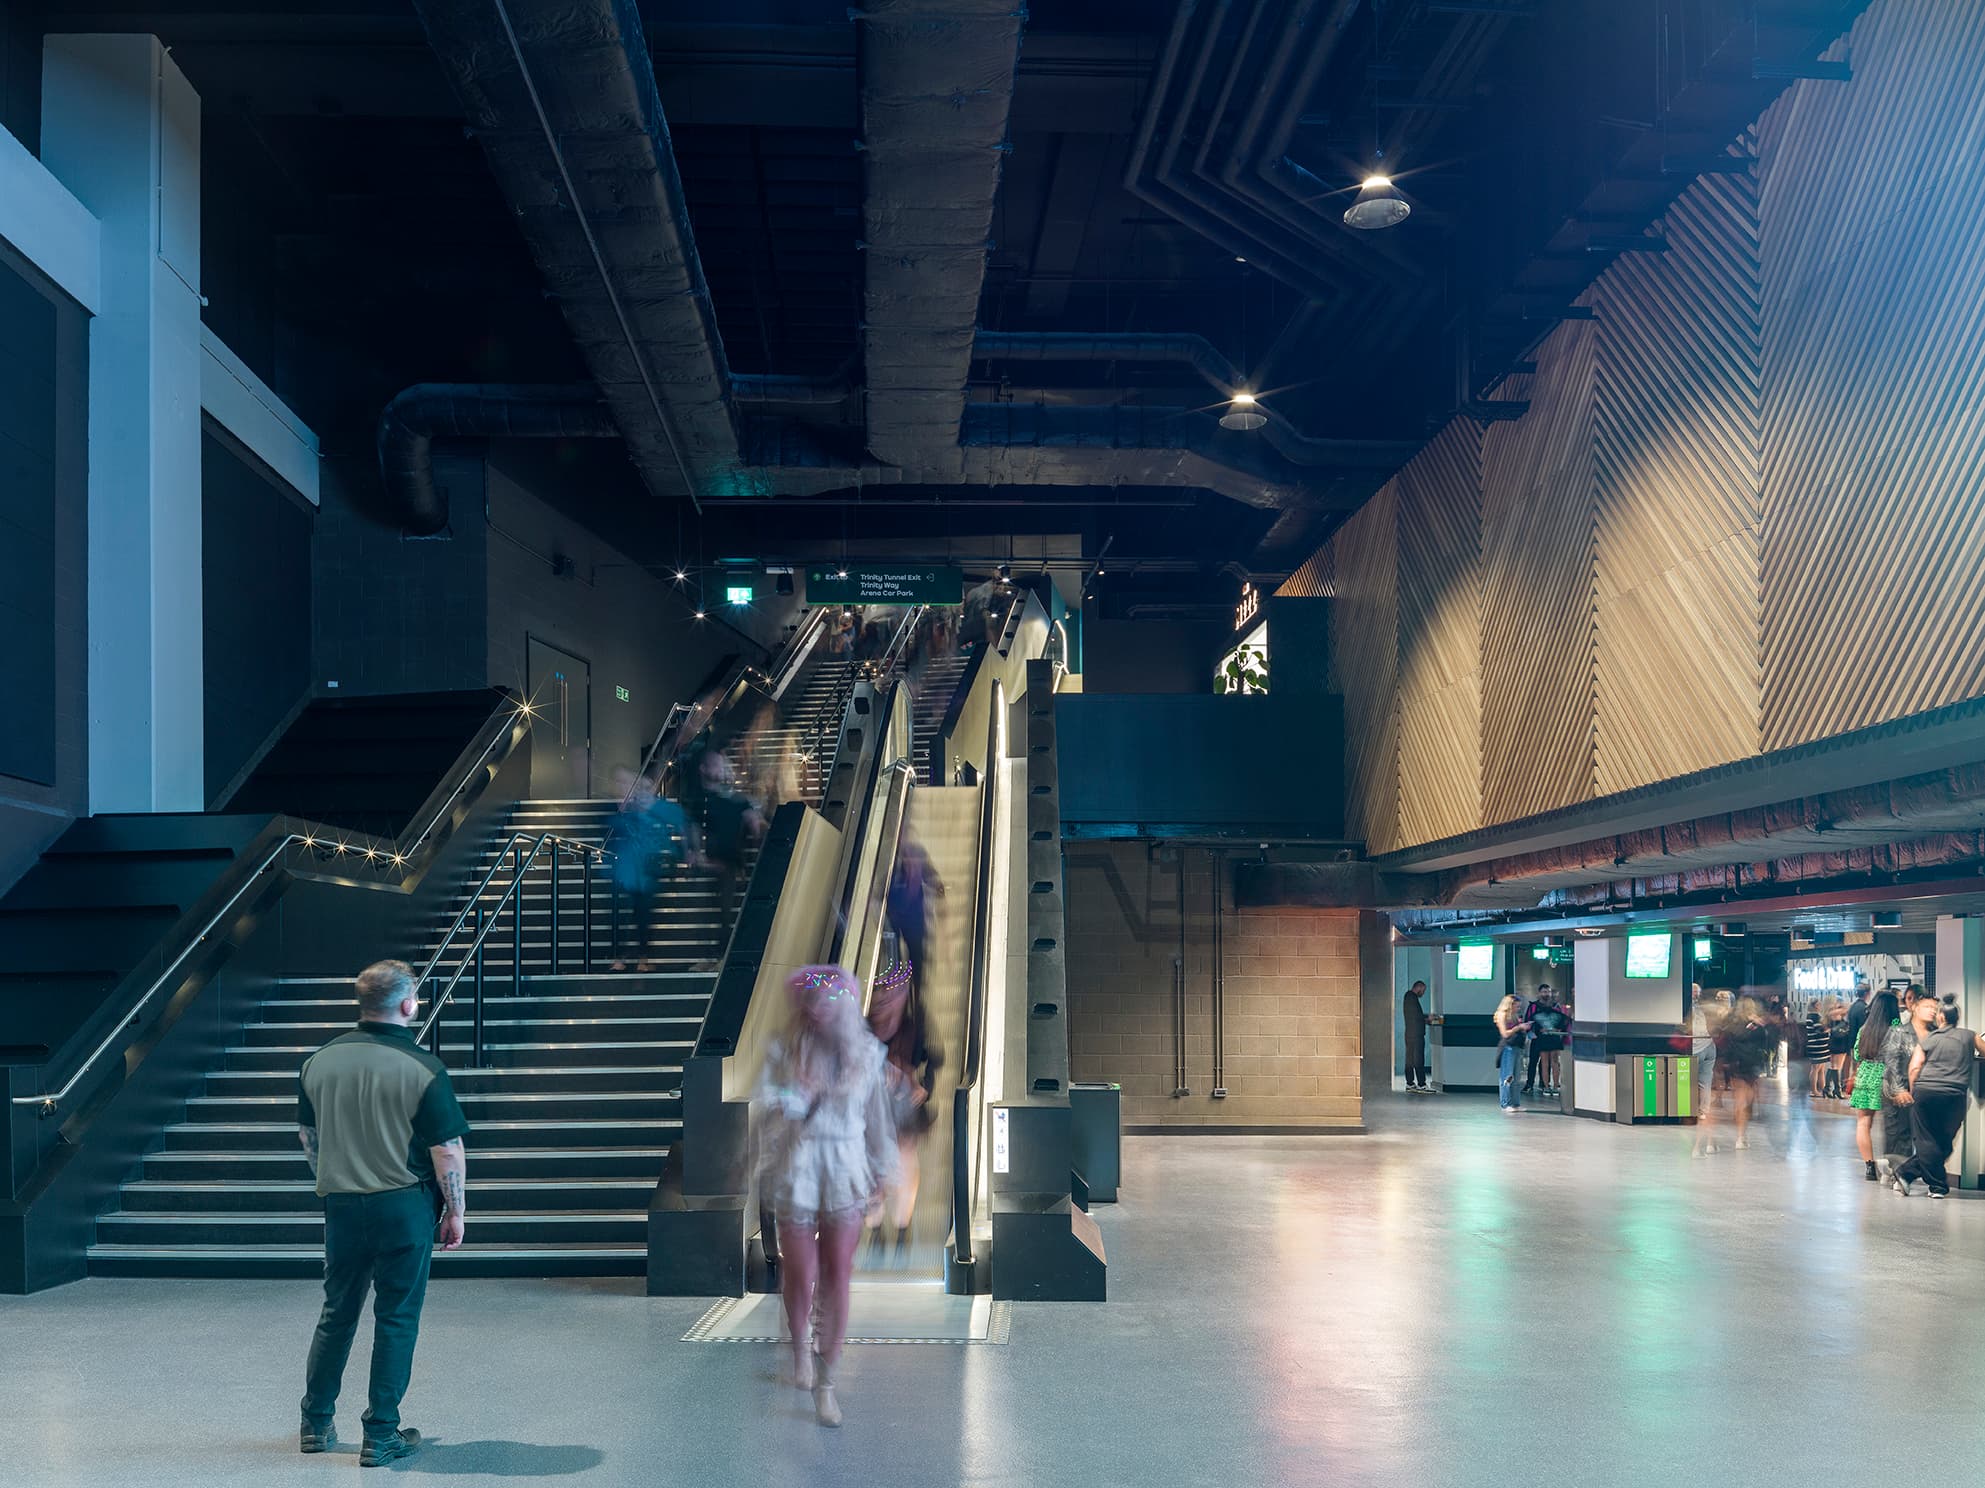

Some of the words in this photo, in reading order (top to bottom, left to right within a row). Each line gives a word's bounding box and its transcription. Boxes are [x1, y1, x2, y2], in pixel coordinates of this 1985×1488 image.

[860, 574, 883, 582] Trinity
[860, 582, 883, 590] Trinity
[884, 582, 900, 590] Way
[1794, 966, 1818, 989] Food
